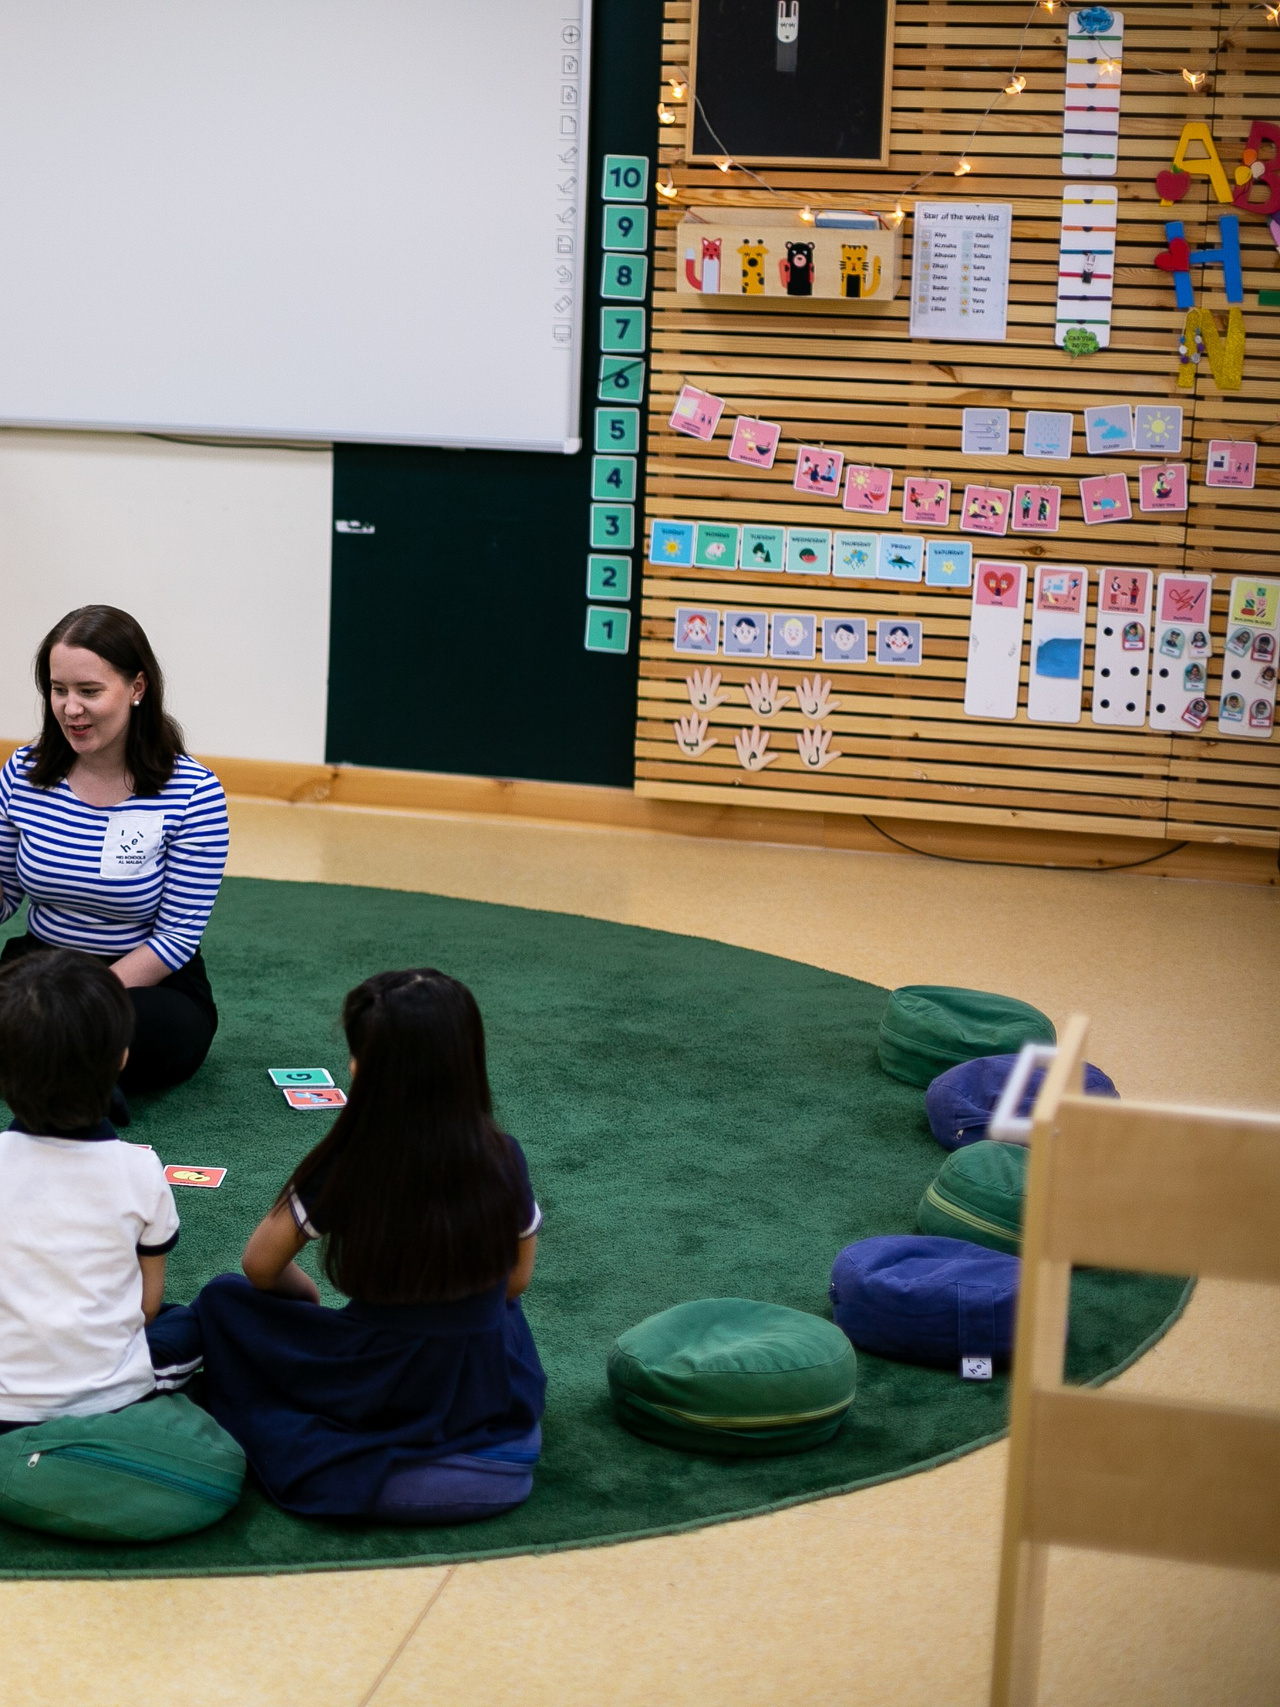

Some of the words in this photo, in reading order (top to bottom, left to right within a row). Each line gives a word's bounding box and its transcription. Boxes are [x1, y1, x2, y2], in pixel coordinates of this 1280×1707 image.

[1159, 122, 1234, 207] A
[609, 166, 642, 188] 10
[618, 216, 634, 238] 9
[950, 213, 964, 222] the
[965, 214, 986, 223] week
[1165, 214, 1244, 309] H
[617, 265, 632, 286] 8
[615, 319, 631, 340] 7
[1176, 306, 1246, 391] N
[614, 372, 629, 389] 6
[610, 419, 625, 440] 5
[607, 468, 622, 488] 4
[605, 515, 620, 536] 3
[602, 567, 617, 587] 2
[602, 620, 613, 640] 1
[699, 694, 707, 704] د
[759, 697, 772, 714] ن
[683, 738, 699, 751] ب
[749, 751, 757, 766] م
[808, 746, 820, 765] ل
[286, 1073, 312, 1081] G
